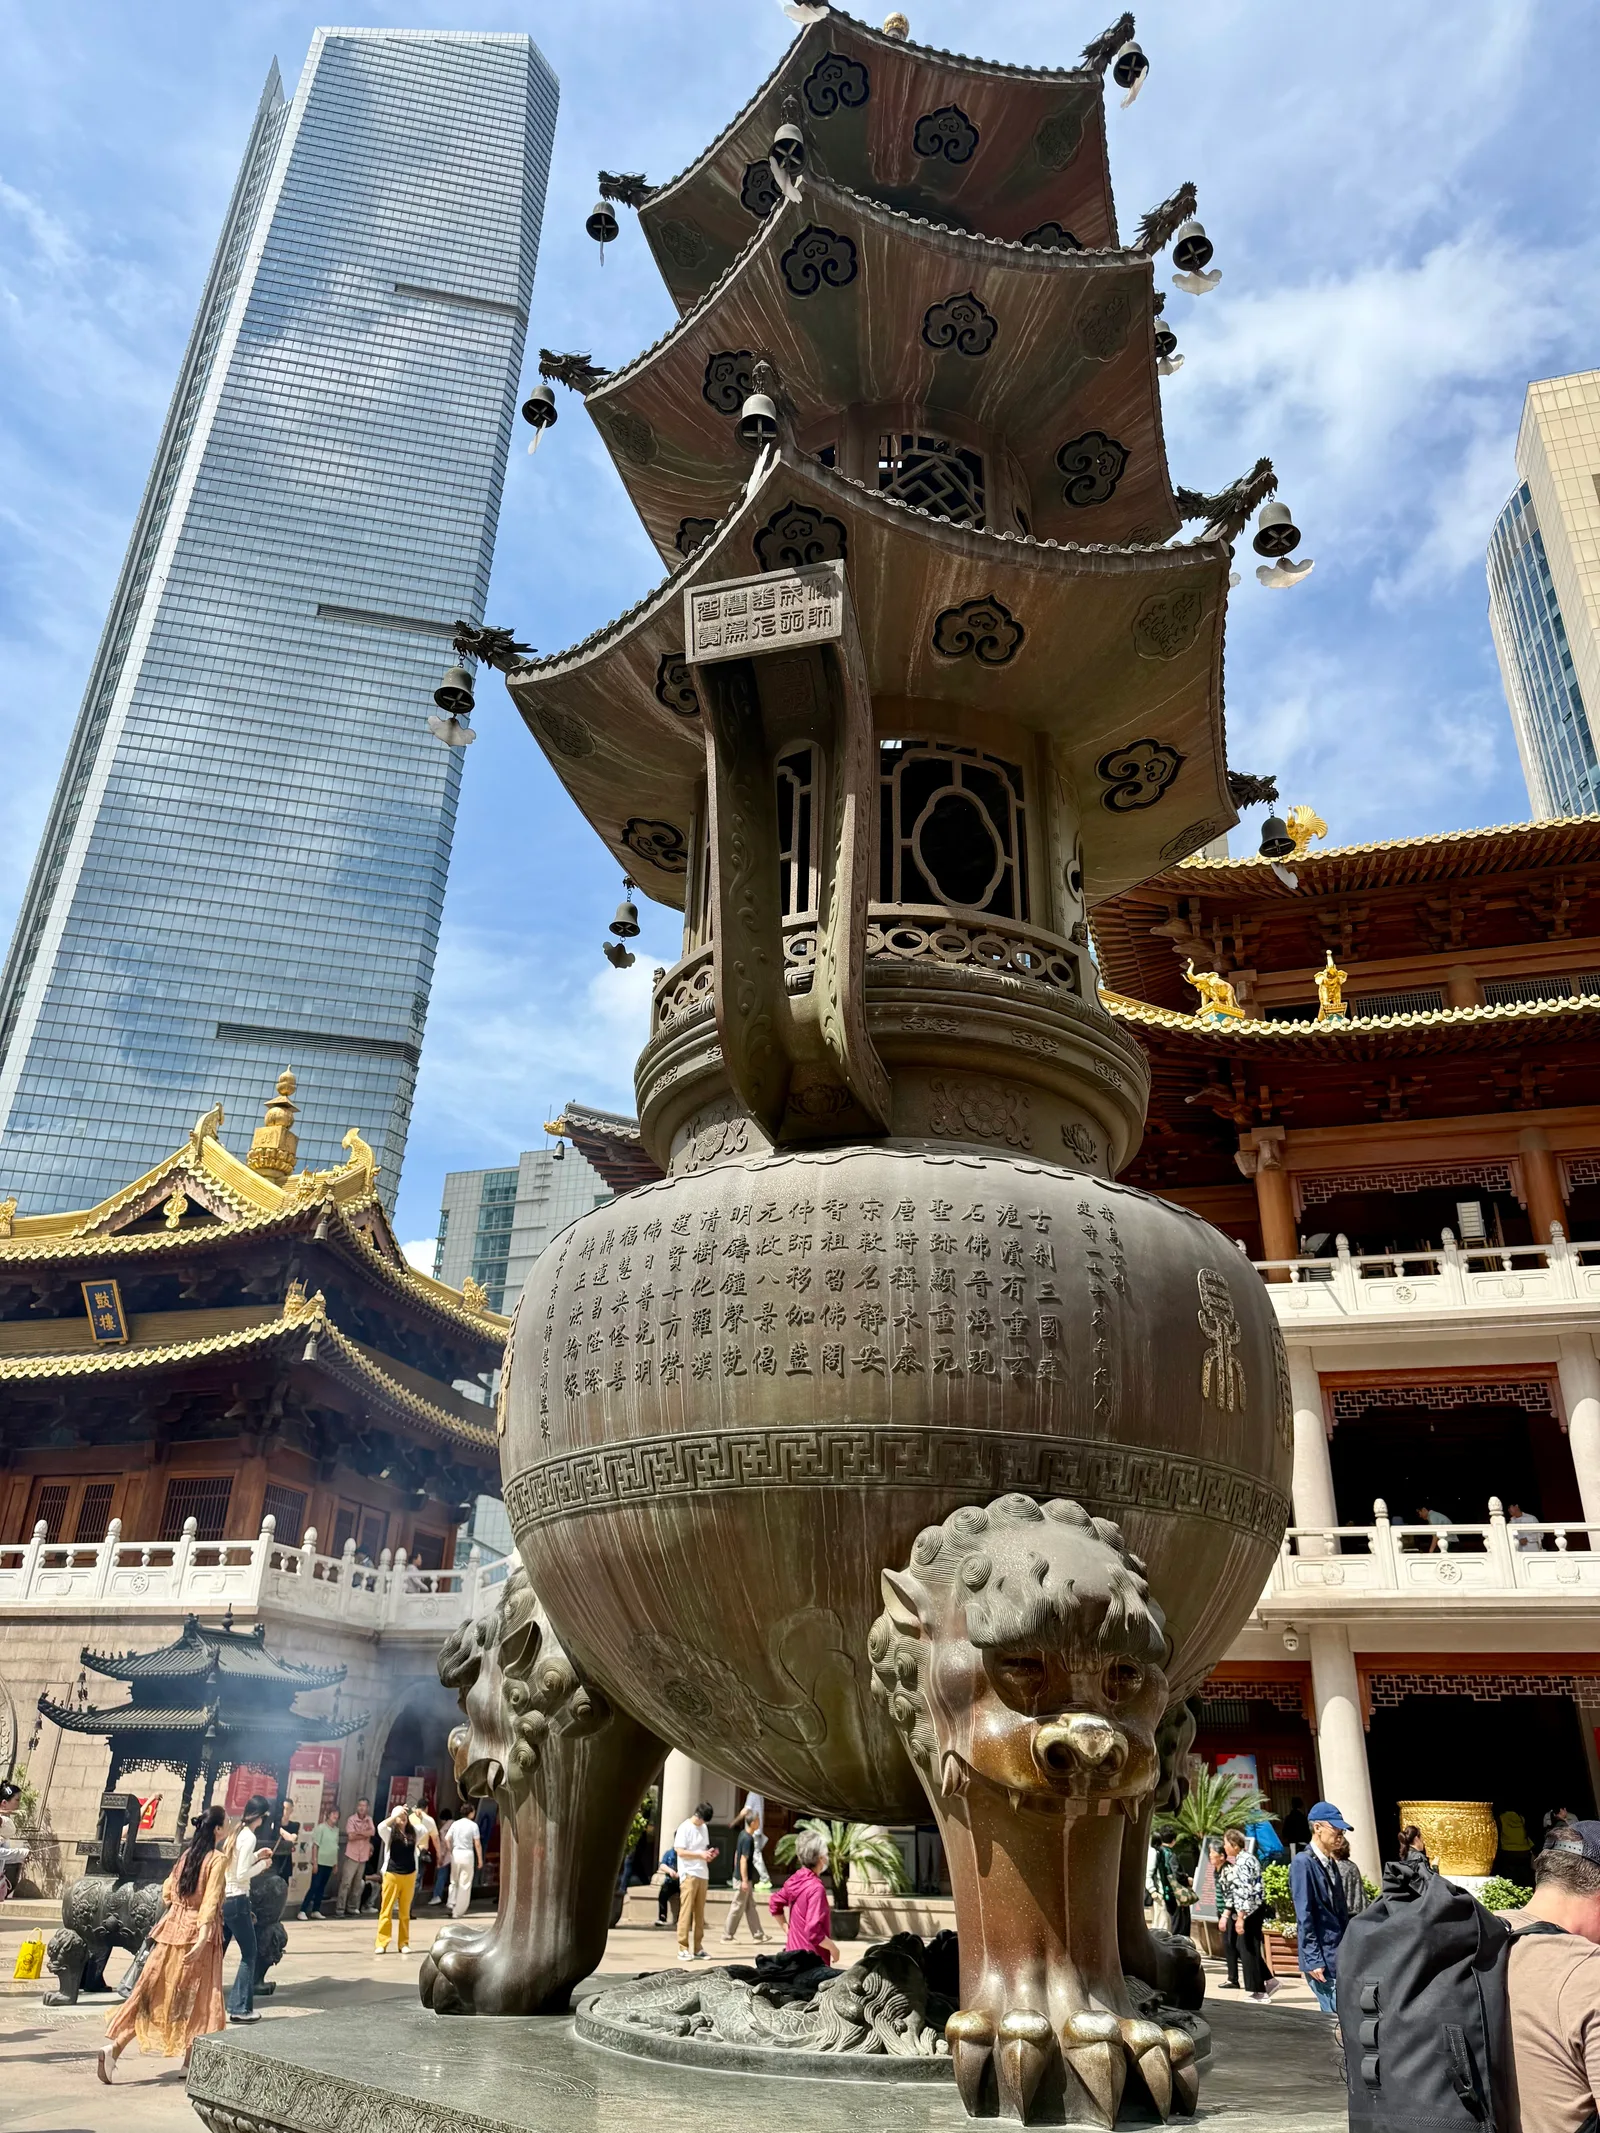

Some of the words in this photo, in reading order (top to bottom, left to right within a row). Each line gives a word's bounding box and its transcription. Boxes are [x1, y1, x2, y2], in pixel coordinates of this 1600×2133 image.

[635, 1218, 662, 1386] 佛日普光明
